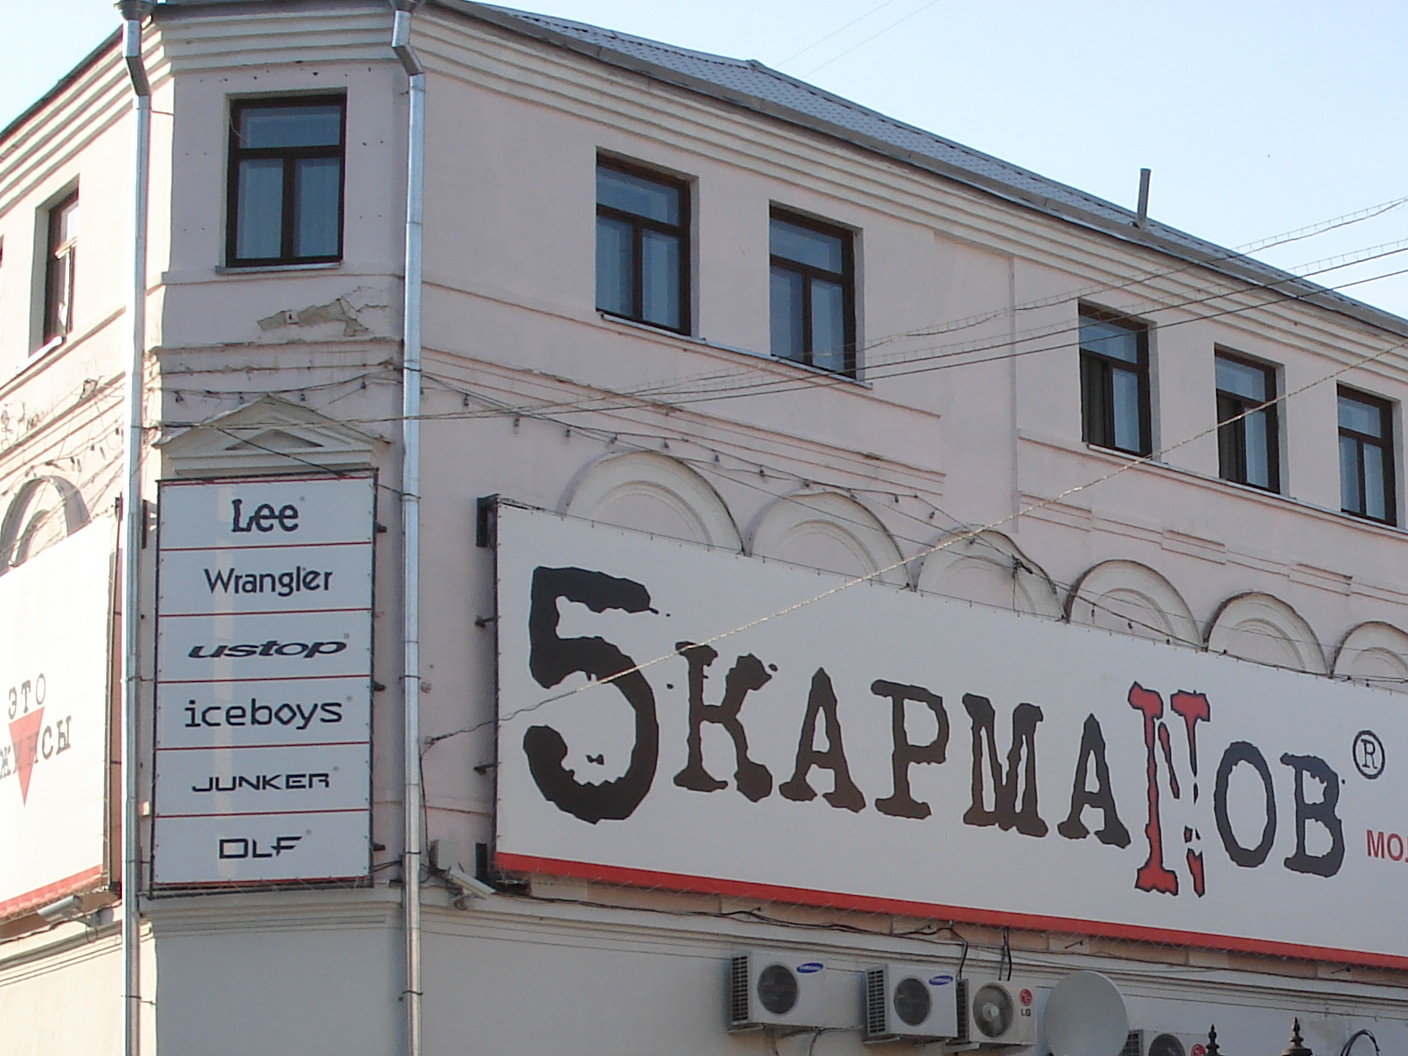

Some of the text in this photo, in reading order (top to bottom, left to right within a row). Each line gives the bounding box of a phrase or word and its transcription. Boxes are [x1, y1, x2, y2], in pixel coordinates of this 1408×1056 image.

[231, 499, 299, 533] Lee
[204, 566, 333, 597] Wrangler
[188, 639, 347, 659] ustop
[8, 672, 46, 720] ЭТО
[185, 697, 343, 730] iceboys
[192, 772, 330, 792] JUNKER
[1020, 1008, 1032, 1017] LG
